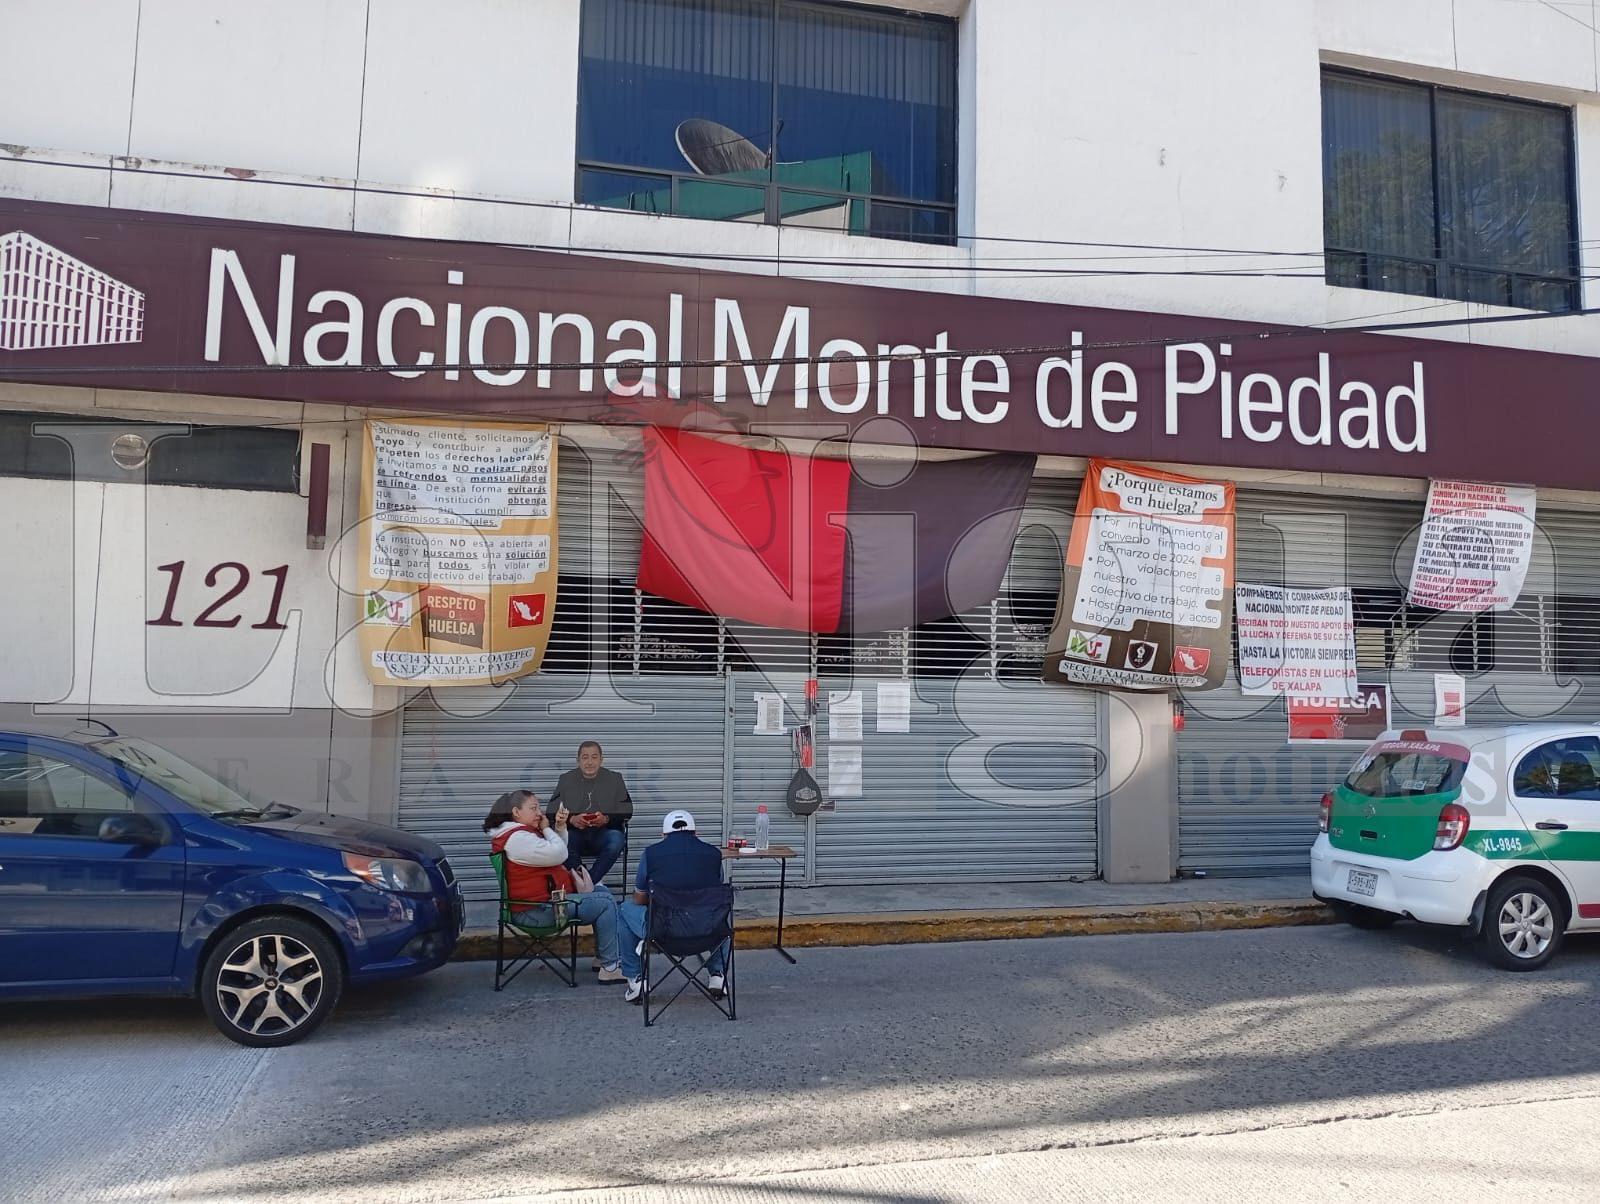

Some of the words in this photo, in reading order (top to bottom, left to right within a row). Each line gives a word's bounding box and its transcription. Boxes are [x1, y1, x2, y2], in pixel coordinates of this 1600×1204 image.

[204, 248, 682, 401] Nacional
[713, 297, 1011, 424] Monte
[1035, 330, 1137, 433] de
[1165, 341, 1428, 453] Piedad
[475, 433, 534, 443] solicitamos
[432, 442, 485, 453] contribuir
[426, 451, 439, 460] los
[445, 452, 494, 463] derechos
[388, 457, 437, 470] invitamos
[453, 464, 469, 473] NO
[474, 465, 516, 473] realizar
[521, 465, 548, 474] pagos
[394, 469, 448, 482] refrendos
[470, 475, 547, 484] mensualidades
[472, 485, 502, 493] forma
[1168, 485, 1218, 502] estamos
[408, 492, 416, 500] la
[434, 495, 490, 504] institución
[507, 496, 547, 506] obtenga
[1127, 494, 1142, 505] en
[1147, 493, 1197, 515] huelga?
[376, 500, 417, 512] ingresos
[475, 507, 512, 516] cumplir
[532, 508, 547, 516] sus
[376, 514, 440, 524] compromisos
[1104, 514, 1120, 527] Por
[1128, 520, 1212, 539] incumplimiento
[1214, 531, 1223, 541] al
[376, 533, 385, 542] La
[392, 535, 443, 545] institución
[450, 539, 465, 547] NO
[500, 539, 533, 548] abierta
[1100, 529, 1150, 545] convenio
[1157, 537, 1201, 552] firmado
[423, 549, 479, 559] buscamos
[505, 550, 546, 560] solución
[1098, 541, 1113, 552] de
[1116, 546, 1150, 560] marzo
[1152, 552, 1168, 562] de
[1171, 553, 1197, 565] 2024.
[407, 560, 429, 568] para
[504, 561, 529, 570] violar
[538, 561, 546, 569] el
[1096, 555, 1116, 568] Por
[1137, 564, 1198, 580] violaciones
[1215, 574, 1221, 582] a
[373, 568, 414, 578] contrato
[418, 572, 464, 580] colectivo
[1093, 571, 1138, 586] nuestro
[1179, 583, 1220, 596] contrato
[145, 560, 289, 629] 121
[1090, 583, 1141, 600] colectivo
[1143, 593, 1158, 603] de
[1160, 595, 1199, 609] trabajo.
[1237, 587, 1283, 602] COMPAÑEROS
[1285, 591, 1290, 600] Y
[1291, 590, 1338, 602] COMPAÑERAS
[1339, 591, 1353, 602] DEL
[427, 595, 476, 612] RESPETO
[1088, 596, 1173, 619] Hostigamiento
[1178, 613, 1186, 622] y
[1189, 613, 1218, 624] acoso
[1245, 603, 1284, 614] NACIONAL
[1285, 605, 1309, 615] MONTE
[1310, 606, 1319, 615] DE
[1320, 606, 1344, 616] PIEDAD
[448, 610, 456, 620] O
[1085, 611, 1126, 626] laboral.
[428, 619, 476, 636] HUELGA
[1238, 618, 1268, 628] RECIBAN
[1270, 620, 1288, 629] TODO
[1290, 620, 1319, 630] NUESTRO
[1321, 621, 1341, 631] APOYO
[1343, 622, 1353, 631] EN
[1239, 630, 1248, 639] LA
[1249, 631, 1274, 640] LUCHA
[1275, 632, 1280, 640] Y
[1282, 632, 1312, 641] DEFENSA
[1313, 633, 1322, 641] DE
[1323, 633, 1332, 642] SU
[409, 654, 420, 664] 14
[423, 654, 470, 665] XALAPA
[480, 650, 533, 664] COATEPEC
[1269, 647, 1280, 659] LA
[1282, 647, 1316, 660] VICTORIA
[1317, 648, 1354, 661] SIEMPRE!!
[1105, 669, 1145, 681] XALAPA
[1241, 666, 1307, 678] TELEFONISTAS
[1310, 668, 1321, 678] EN
[1323, 668, 1356, 678] LUCHA
[1272, 681, 1284, 691] DE
[1287, 681, 1322, 692] XALAPA
[1293, 691, 1382, 709] HUELGA
[1408, 742, 1440, 751] XALAPA
[1482, 837, 1521, 851] XL-9845
